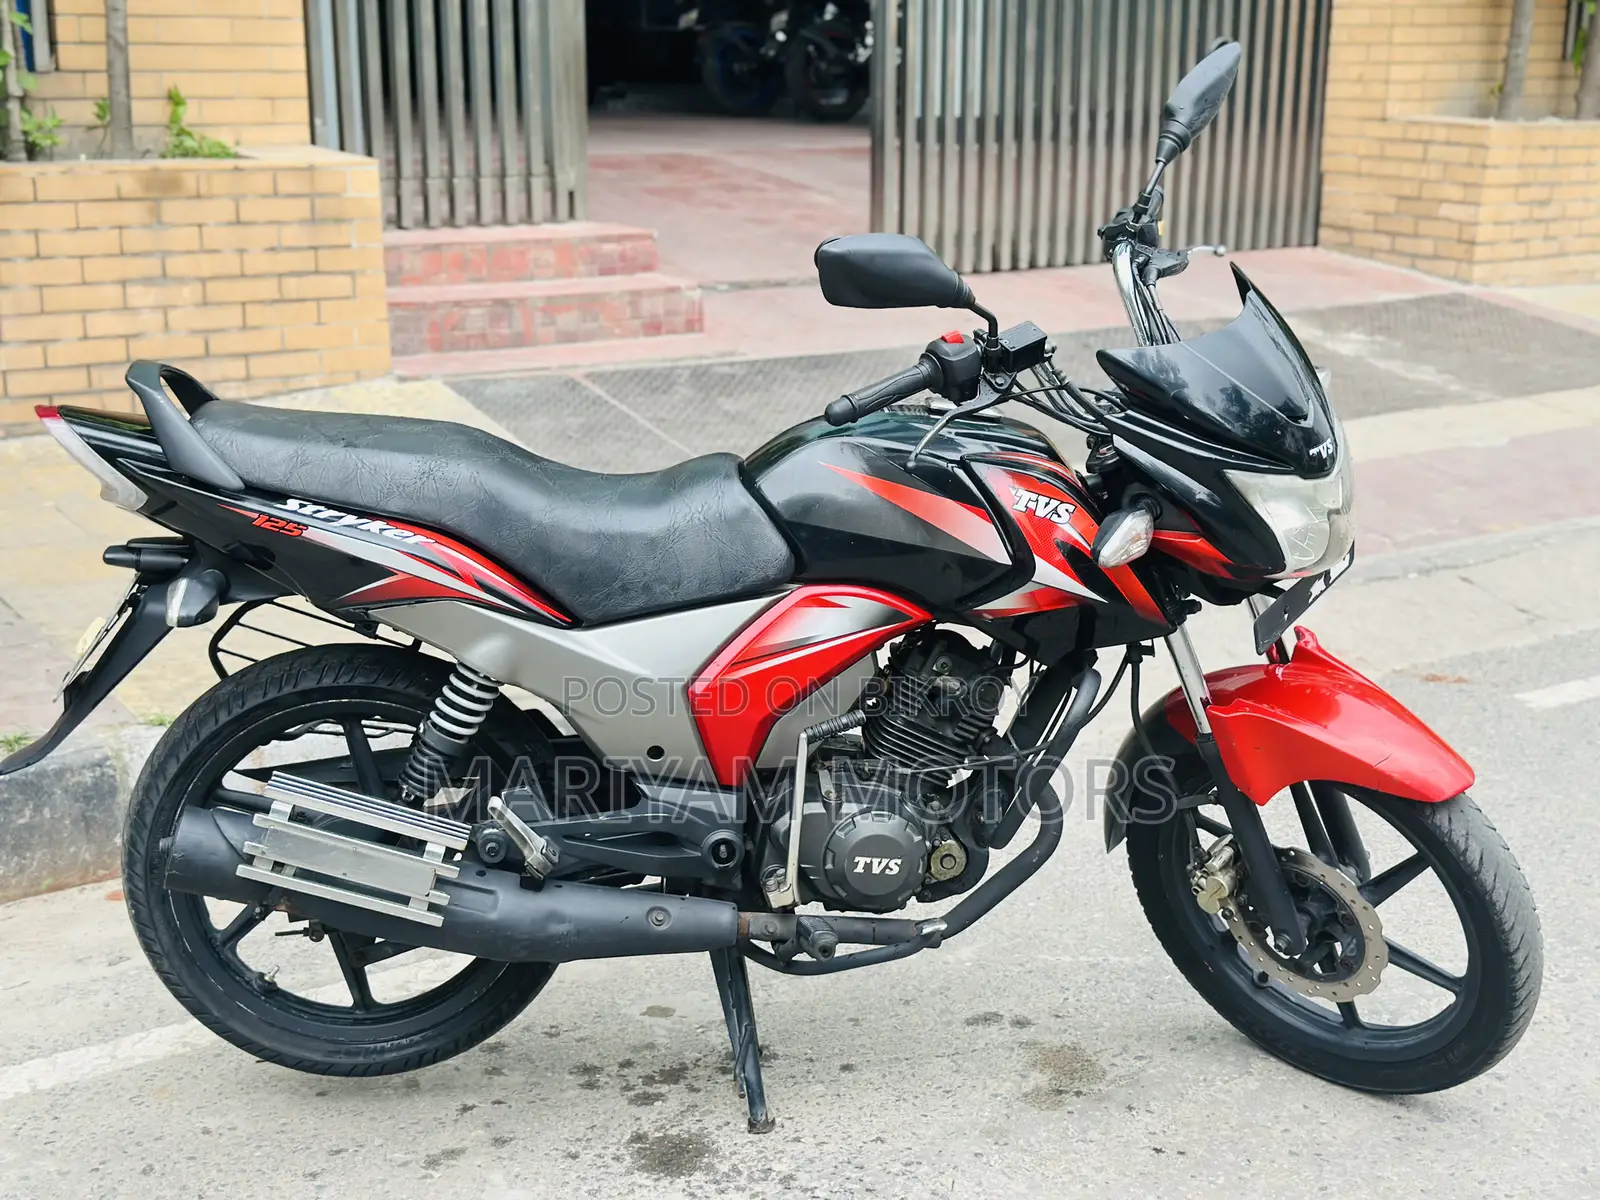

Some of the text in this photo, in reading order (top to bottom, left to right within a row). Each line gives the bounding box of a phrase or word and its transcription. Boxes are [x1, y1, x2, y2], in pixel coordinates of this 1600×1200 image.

[1010, 487, 1078, 525] TVS
[252, 514, 309, 537] 125
[274, 498, 437, 545] Stryker
[853, 856, 903, 875] TVS
